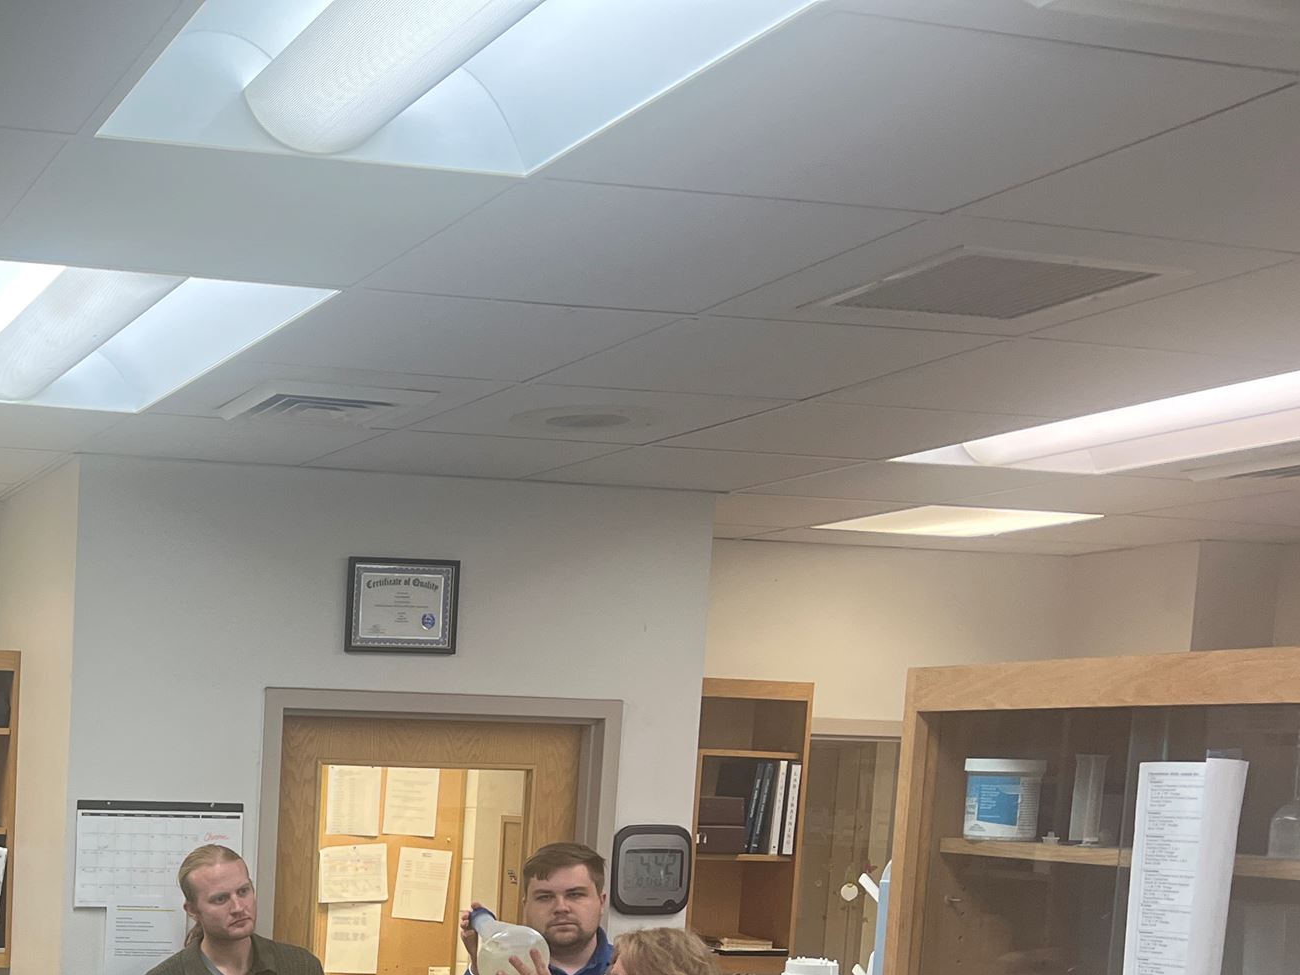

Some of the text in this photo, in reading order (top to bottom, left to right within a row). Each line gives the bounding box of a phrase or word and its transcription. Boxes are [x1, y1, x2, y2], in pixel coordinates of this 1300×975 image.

[366, 578, 439, 592] Certificate of Quality
